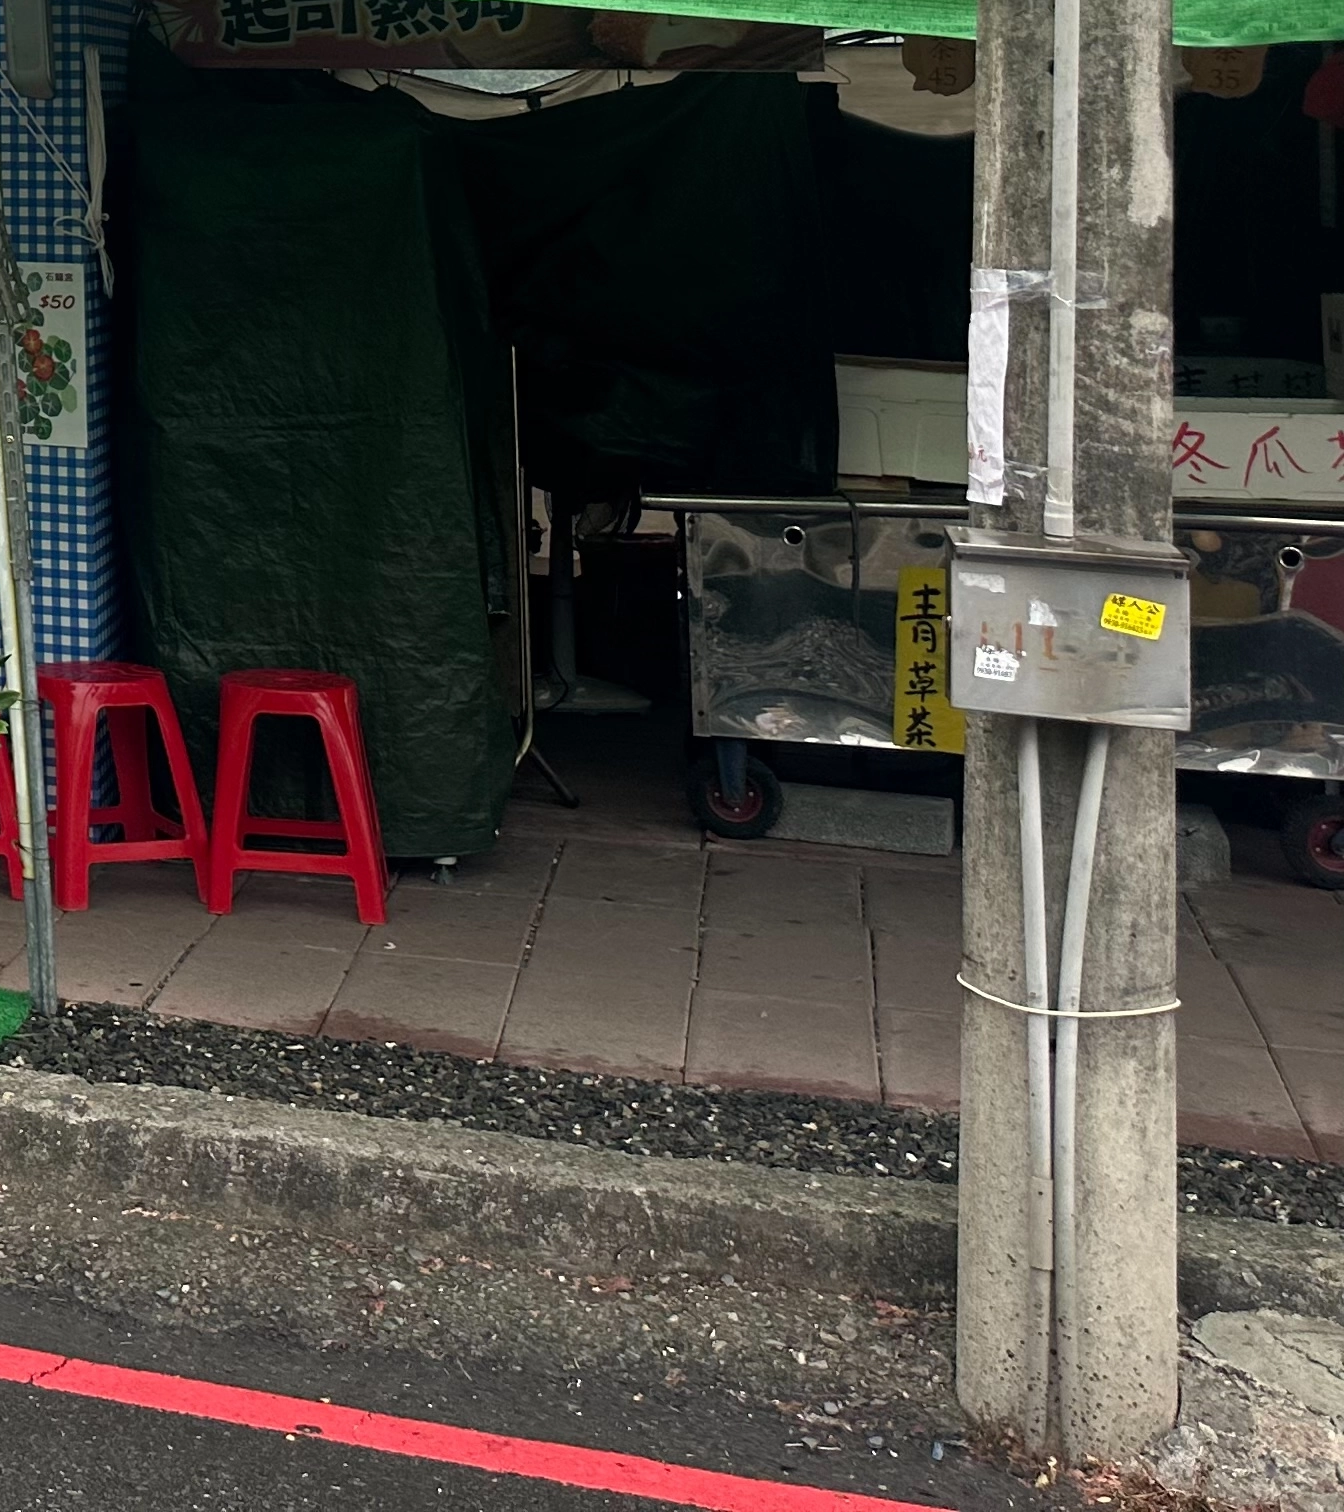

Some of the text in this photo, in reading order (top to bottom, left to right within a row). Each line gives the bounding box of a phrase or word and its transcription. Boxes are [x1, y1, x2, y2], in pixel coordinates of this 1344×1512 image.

[928, 67, 957, 86] 45
[1208, 69, 1240, 88] 35
[39, 294, 75, 309] $50
[899, 583, 946, 747] 青草茶
